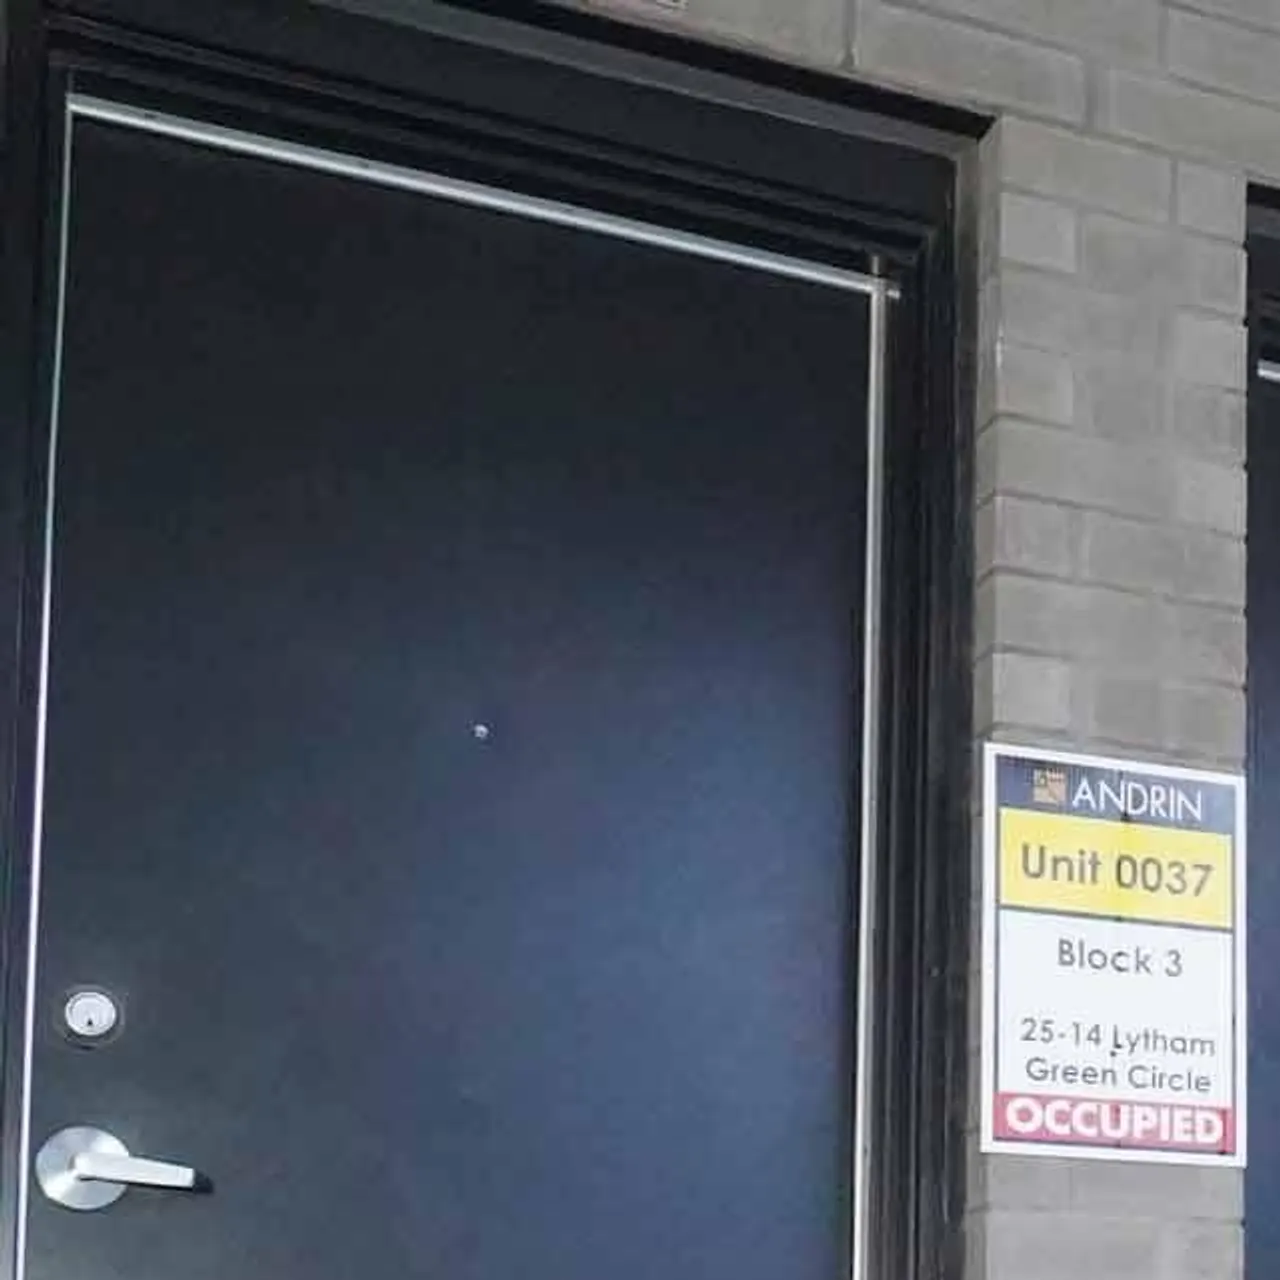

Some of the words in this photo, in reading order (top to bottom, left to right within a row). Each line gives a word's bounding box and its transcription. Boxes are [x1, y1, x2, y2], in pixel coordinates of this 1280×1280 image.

[1072, 777, 1202, 822] ANDRIN
[1021, 842, 1102, 887] Unit
[1116, 854, 1215, 897] 0037
[1057, 938, 1153, 975] Block
[1165, 949, 1184, 977] 3
[1020, 1017, 1102, 1047] 25-14
[1112, 1023, 1216, 1057] Lytham
[1025, 1057, 1117, 1087] Green
[1128, 1064, 1212, 1094] Circle
[1006, 1098, 1225, 1145] OCCUPIED
